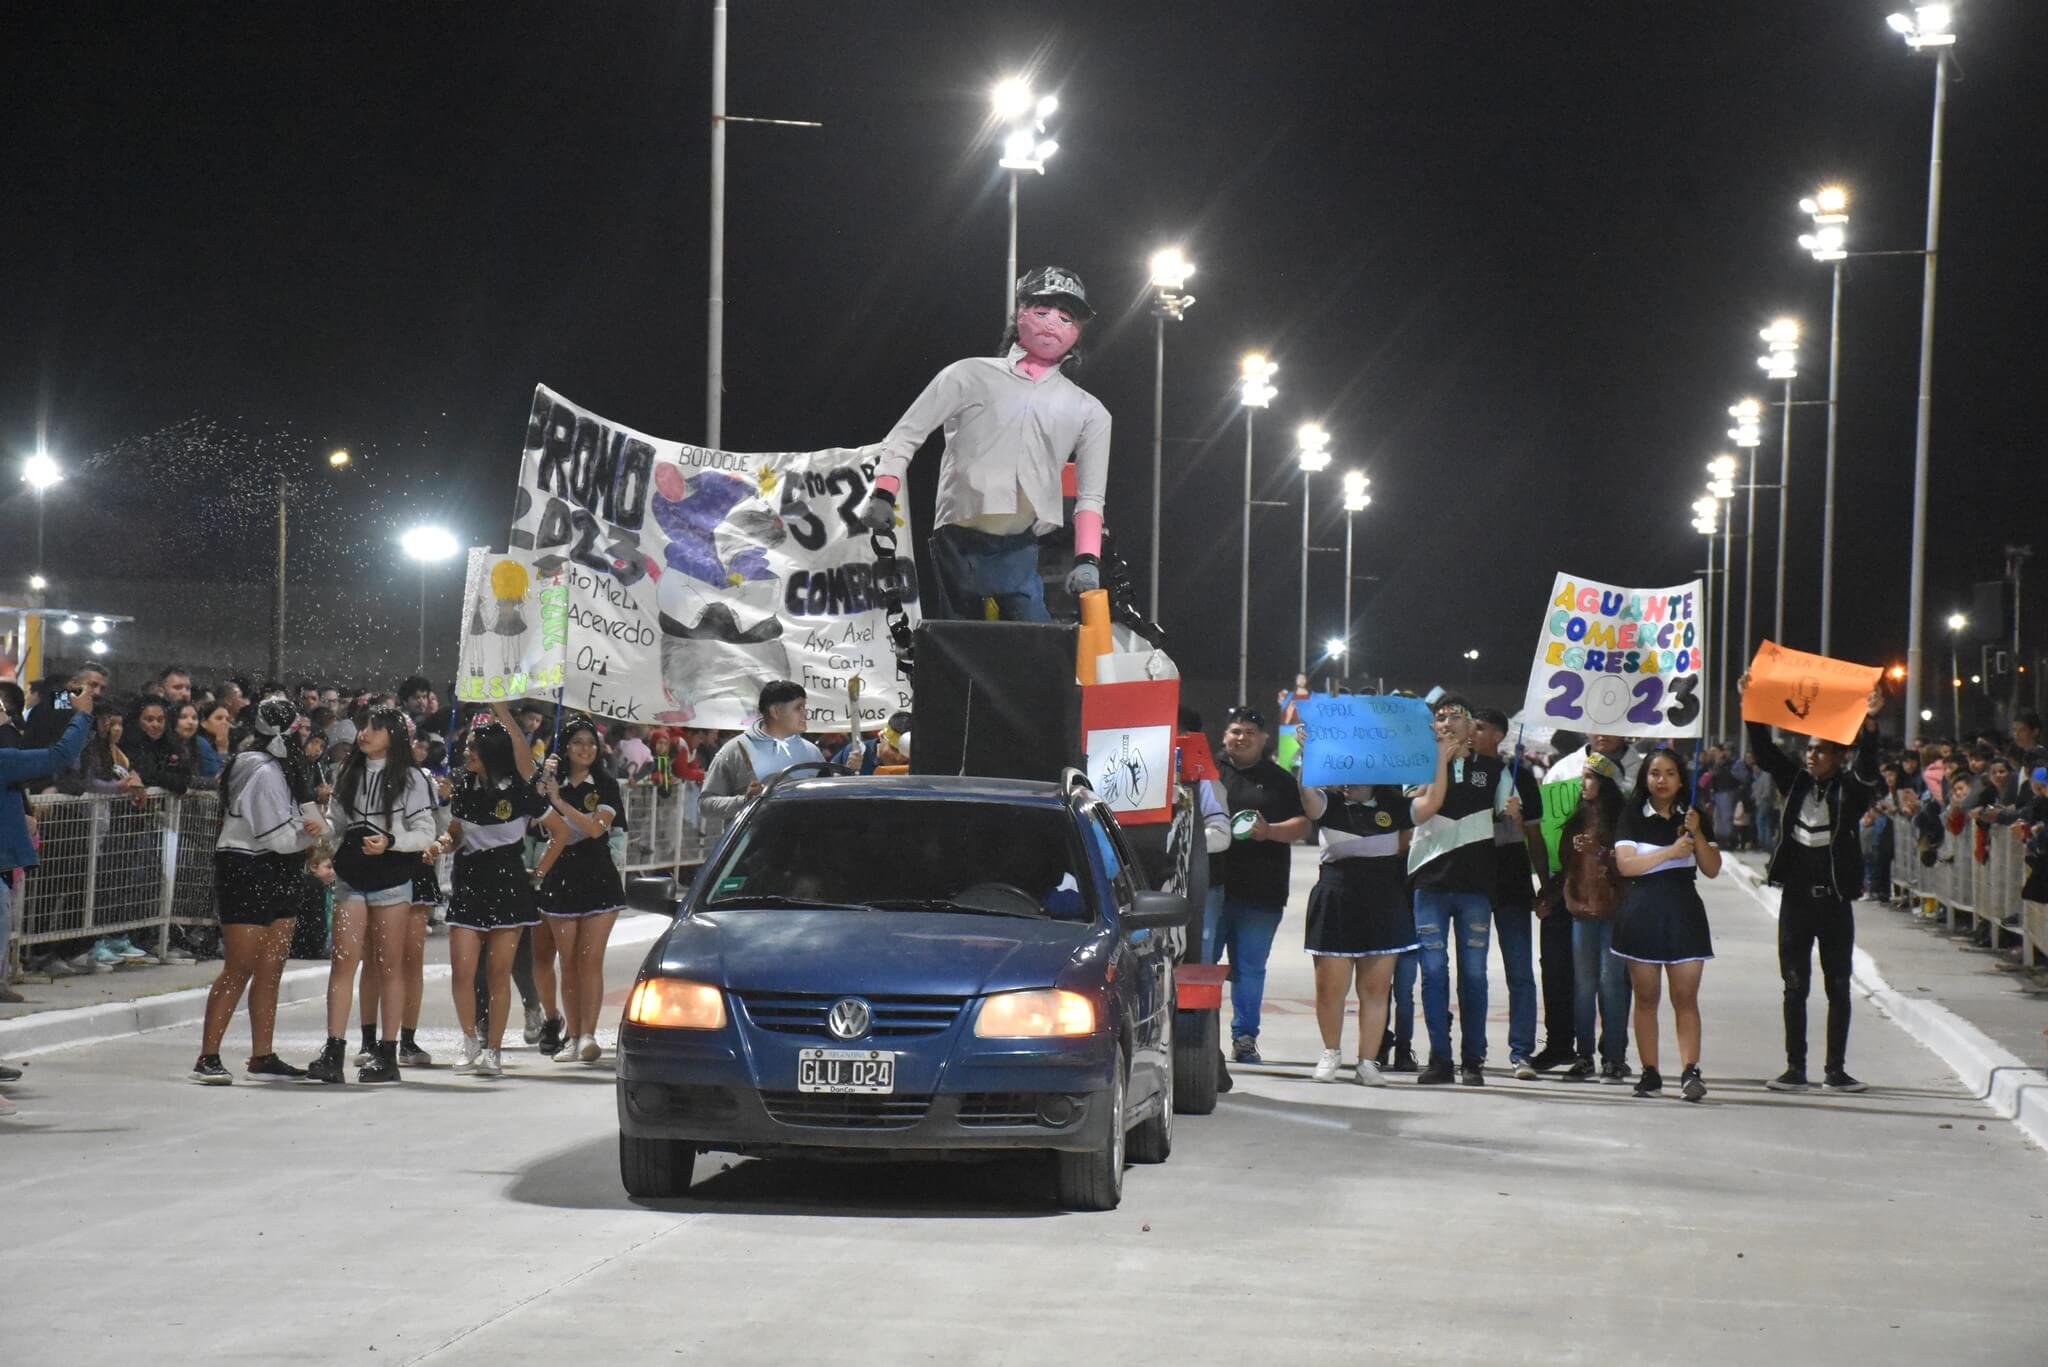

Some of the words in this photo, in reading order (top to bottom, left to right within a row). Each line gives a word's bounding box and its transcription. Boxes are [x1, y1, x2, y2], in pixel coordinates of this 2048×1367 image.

[525, 391, 656, 531] PROMO
[679, 446, 751, 472] BODOQUE
[1554, 581, 1693, 622] AGUANTE
[568, 603, 655, 646] Acevedo
[842, 620, 875, 643] Axel
[828, 654, 875, 670] Carla
[1545, 641, 1702, 674] EGRESADOS
[1545, 670, 1700, 727] 2023
[806, 708, 835, 722] ara
[1323, 754, 1354, 770] ALGO
[802, 1060, 840, 1084] GLU
[852, 1061, 890, 1085] 024
